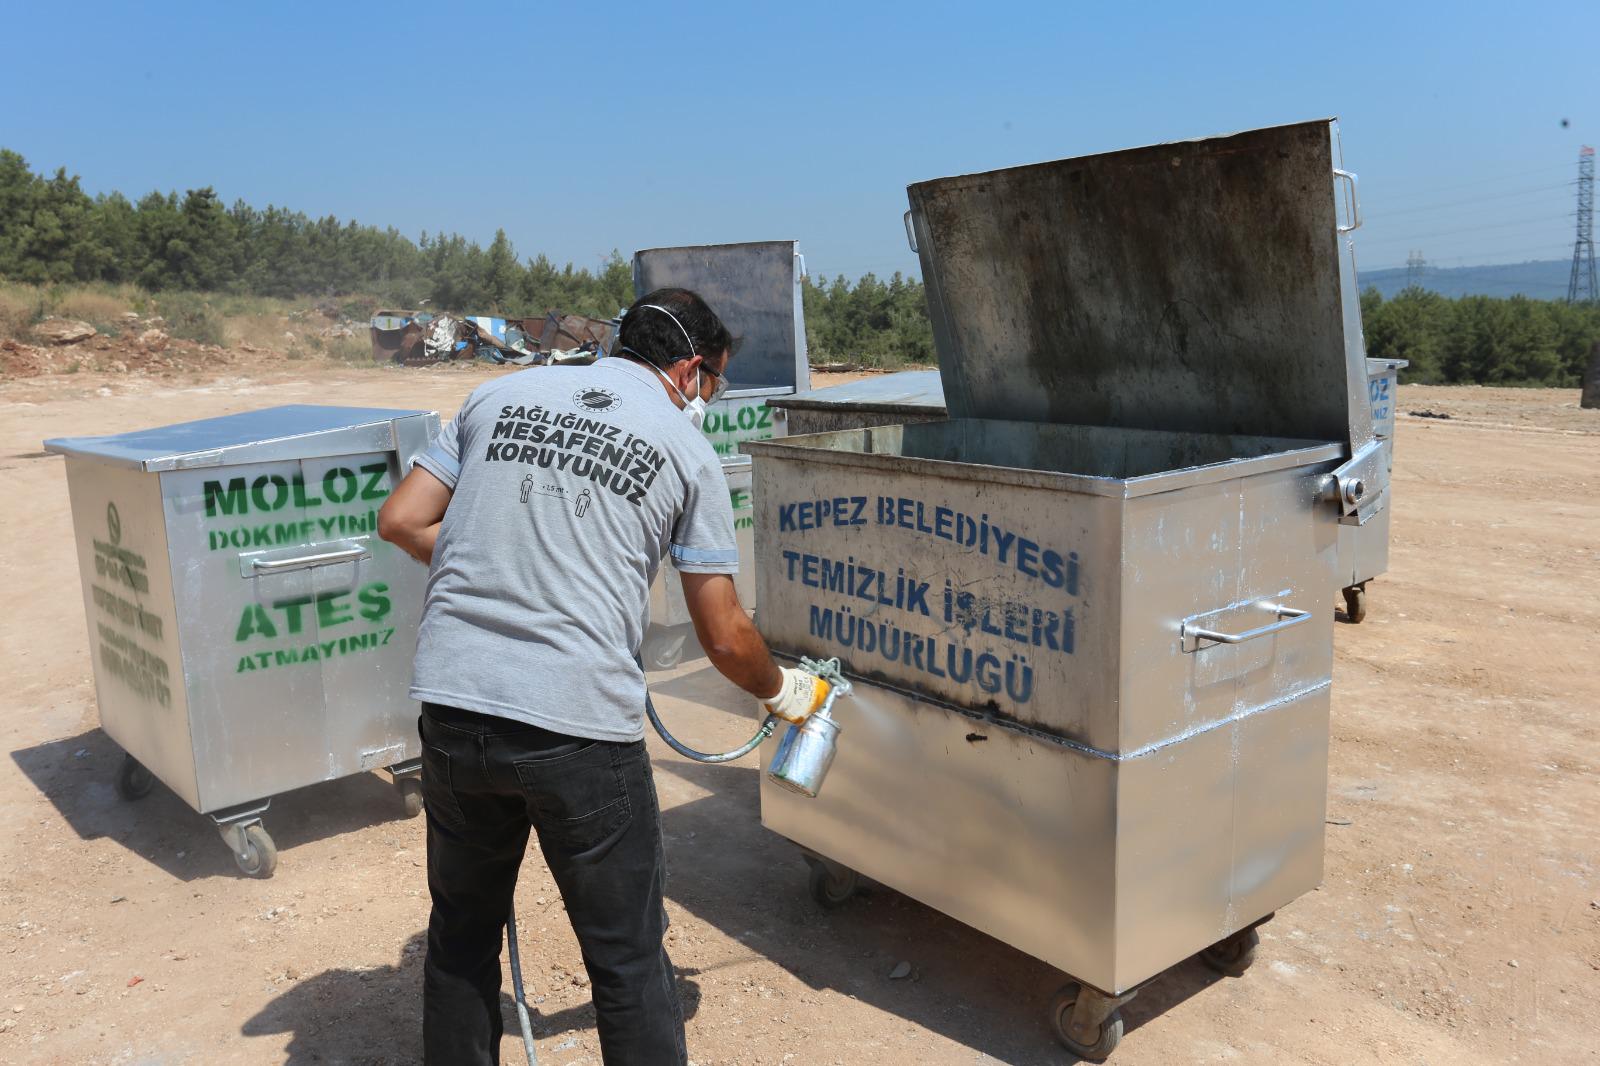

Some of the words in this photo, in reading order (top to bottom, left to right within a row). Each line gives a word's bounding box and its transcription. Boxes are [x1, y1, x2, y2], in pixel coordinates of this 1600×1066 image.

[499, 405, 622, 439] SAĞLIĞINIZ
[623, 433, 667, 472] İÇİN
[703, 405, 772, 434] OLOZ
[485, 443, 648, 507] KORUYUNUZ
[491, 421, 658, 490] MESAFENİZİ
[204, 462, 390, 517] MOLOZ
[779, 496, 868, 532] KEPEZ
[877, 496, 1080, 597] BELEDİYESİ
[782, 550, 931, 617] TEMİZLİK
[944, 578, 1076, 654] İŞLERİ
[237, 626, 395, 673] ATMAYINIZ
